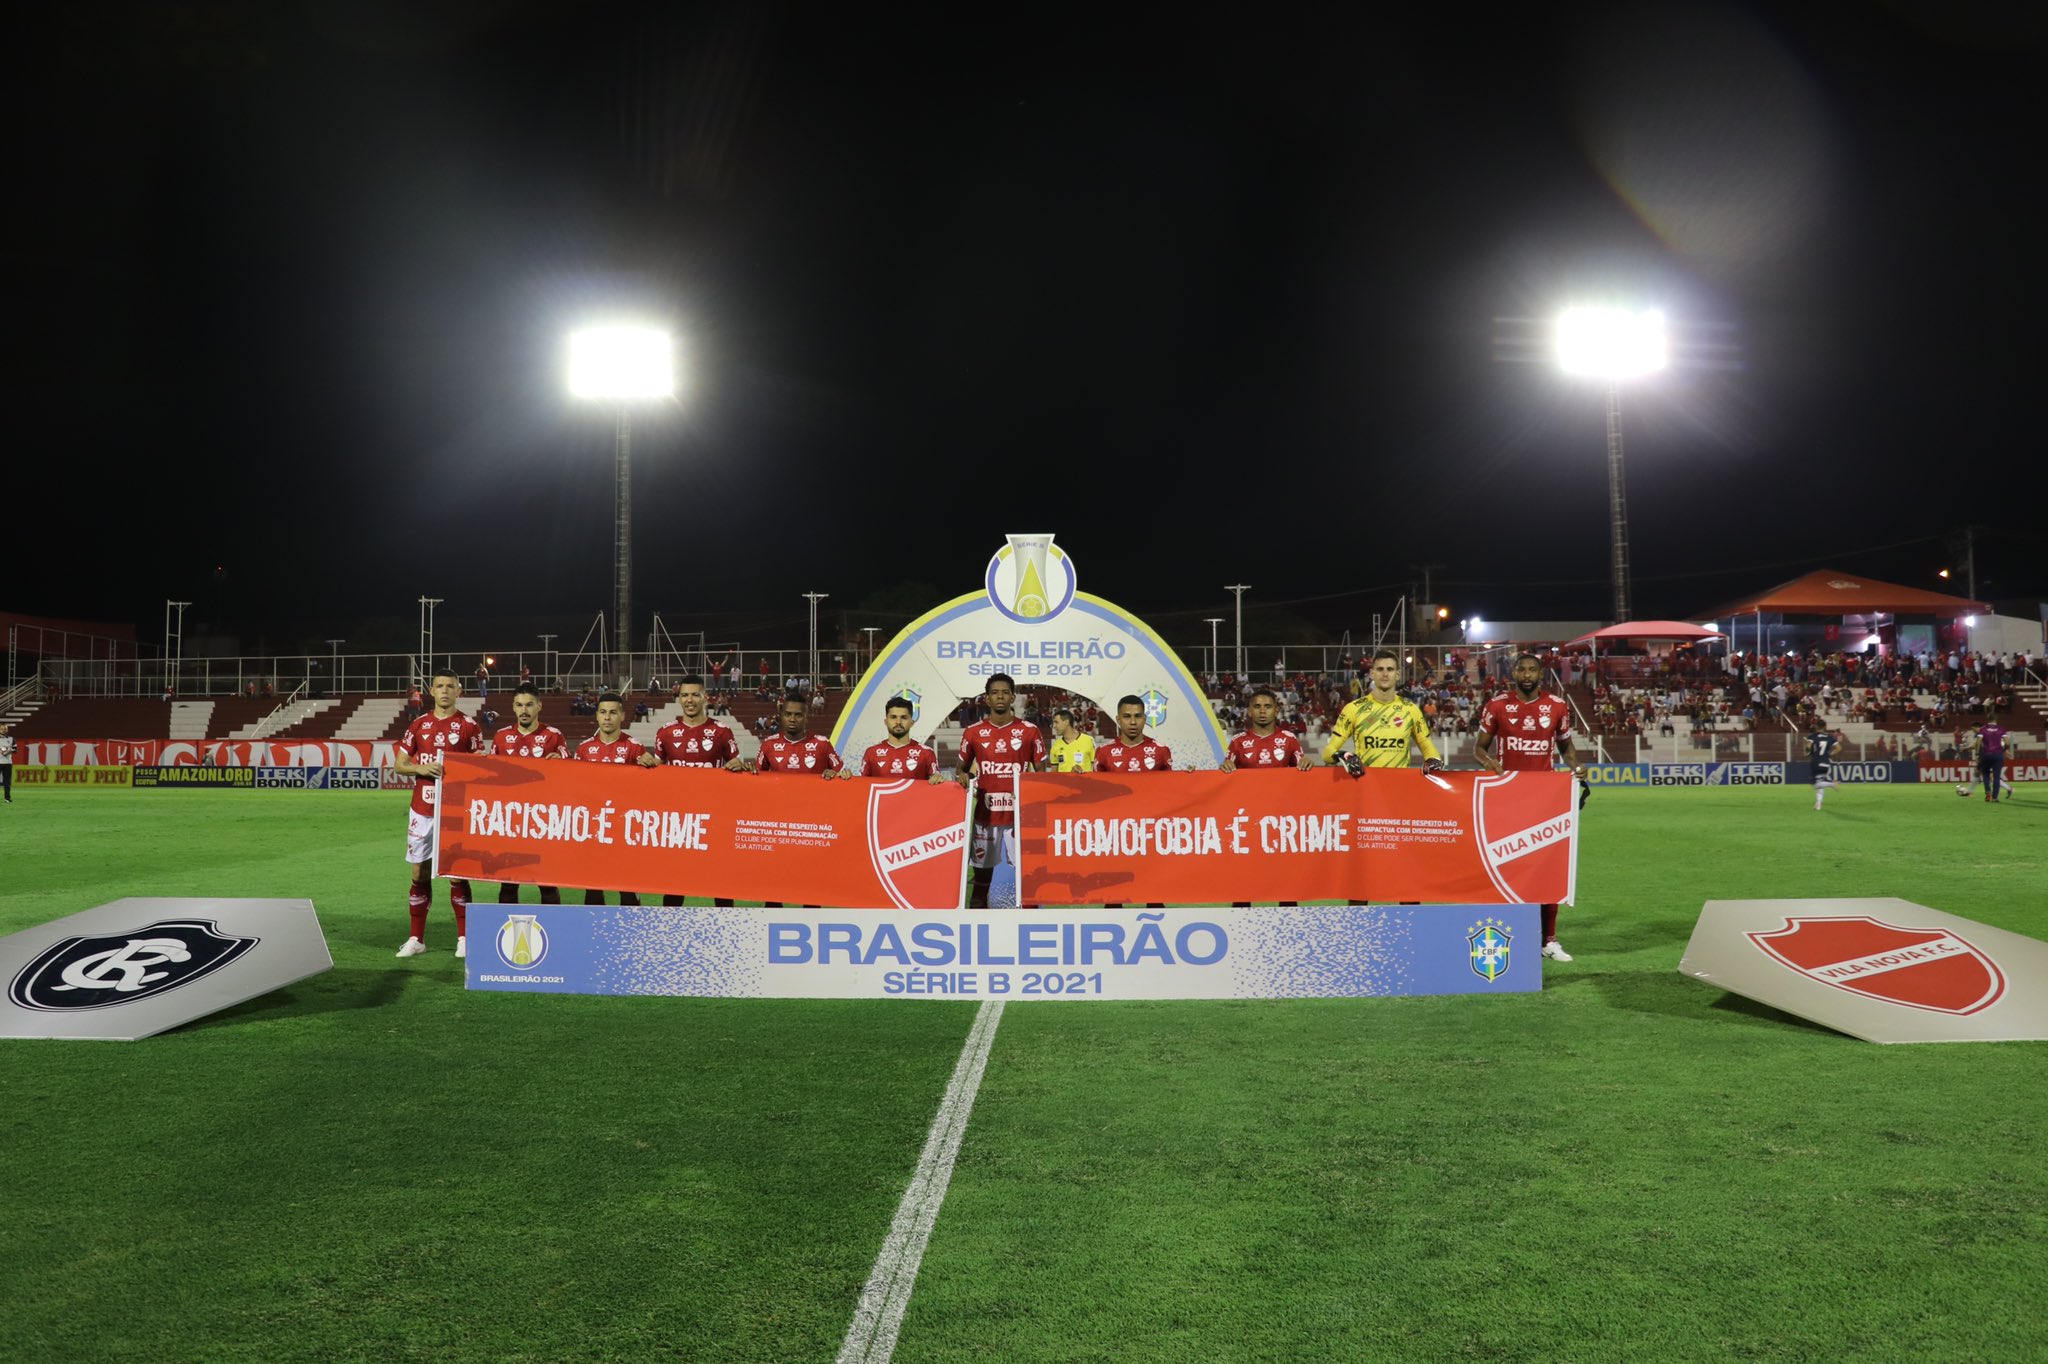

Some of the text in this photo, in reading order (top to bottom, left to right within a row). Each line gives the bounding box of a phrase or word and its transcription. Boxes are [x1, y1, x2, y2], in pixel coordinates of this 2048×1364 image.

[936, 637, 1126, 660] BRASILEIRÃO
[968, 661, 1092, 676] SÉRIE B 2021
[135, 768, 158, 776] PESCA
[158, 768, 253, 782] AMAZONLORD
[260, 769, 304, 779] TEK
[332, 769, 378, 780] TEK
[1587, 766, 1647, 784] OCIAL
[1653, 765, 1702, 776] TEK
[1732, 764, 1781, 775] TEK
[2012, 766, 2048, 781] EAD
[257, 779, 305, 788] BOND
[330, 779, 379, 789] BOND
[1652, 776, 1703, 786] BOND
[1731, 775, 1782, 785] BOND
[469, 799, 711, 851] RACISMO É CRIME
[736, 819, 778, 828] VILANOVENSE
[789, 823, 818, 831] RESPEITO
[1357, 818, 1401, 826] VILANOVENSE
[1412, 819, 1442, 827] RESPEITO
[735, 827, 773, 836] COMPACTUA
[1053, 808, 1350, 857] HOMOFOBIA É CRIME
[1357, 826, 1395, 834] COMPACTUA
[791, 838, 814, 847] PUNIDO
[1440, 836, 1456, 844] PELA
[1492, 818, 1571, 858] VILA NOVA
[735, 842, 747, 850] SUA
[885, 828, 965, 865] VILA NOVA
[767, 912, 1229, 966] BRASILEIRÃO
[1481, 948, 1498, 956] CBF
[1818, 943, 1960, 978] VILA NOVA F.C.
[480, 974, 564, 984] BRASILEIRÃO 2021
[883, 967, 1102, 995] SÉRIE B 2021
